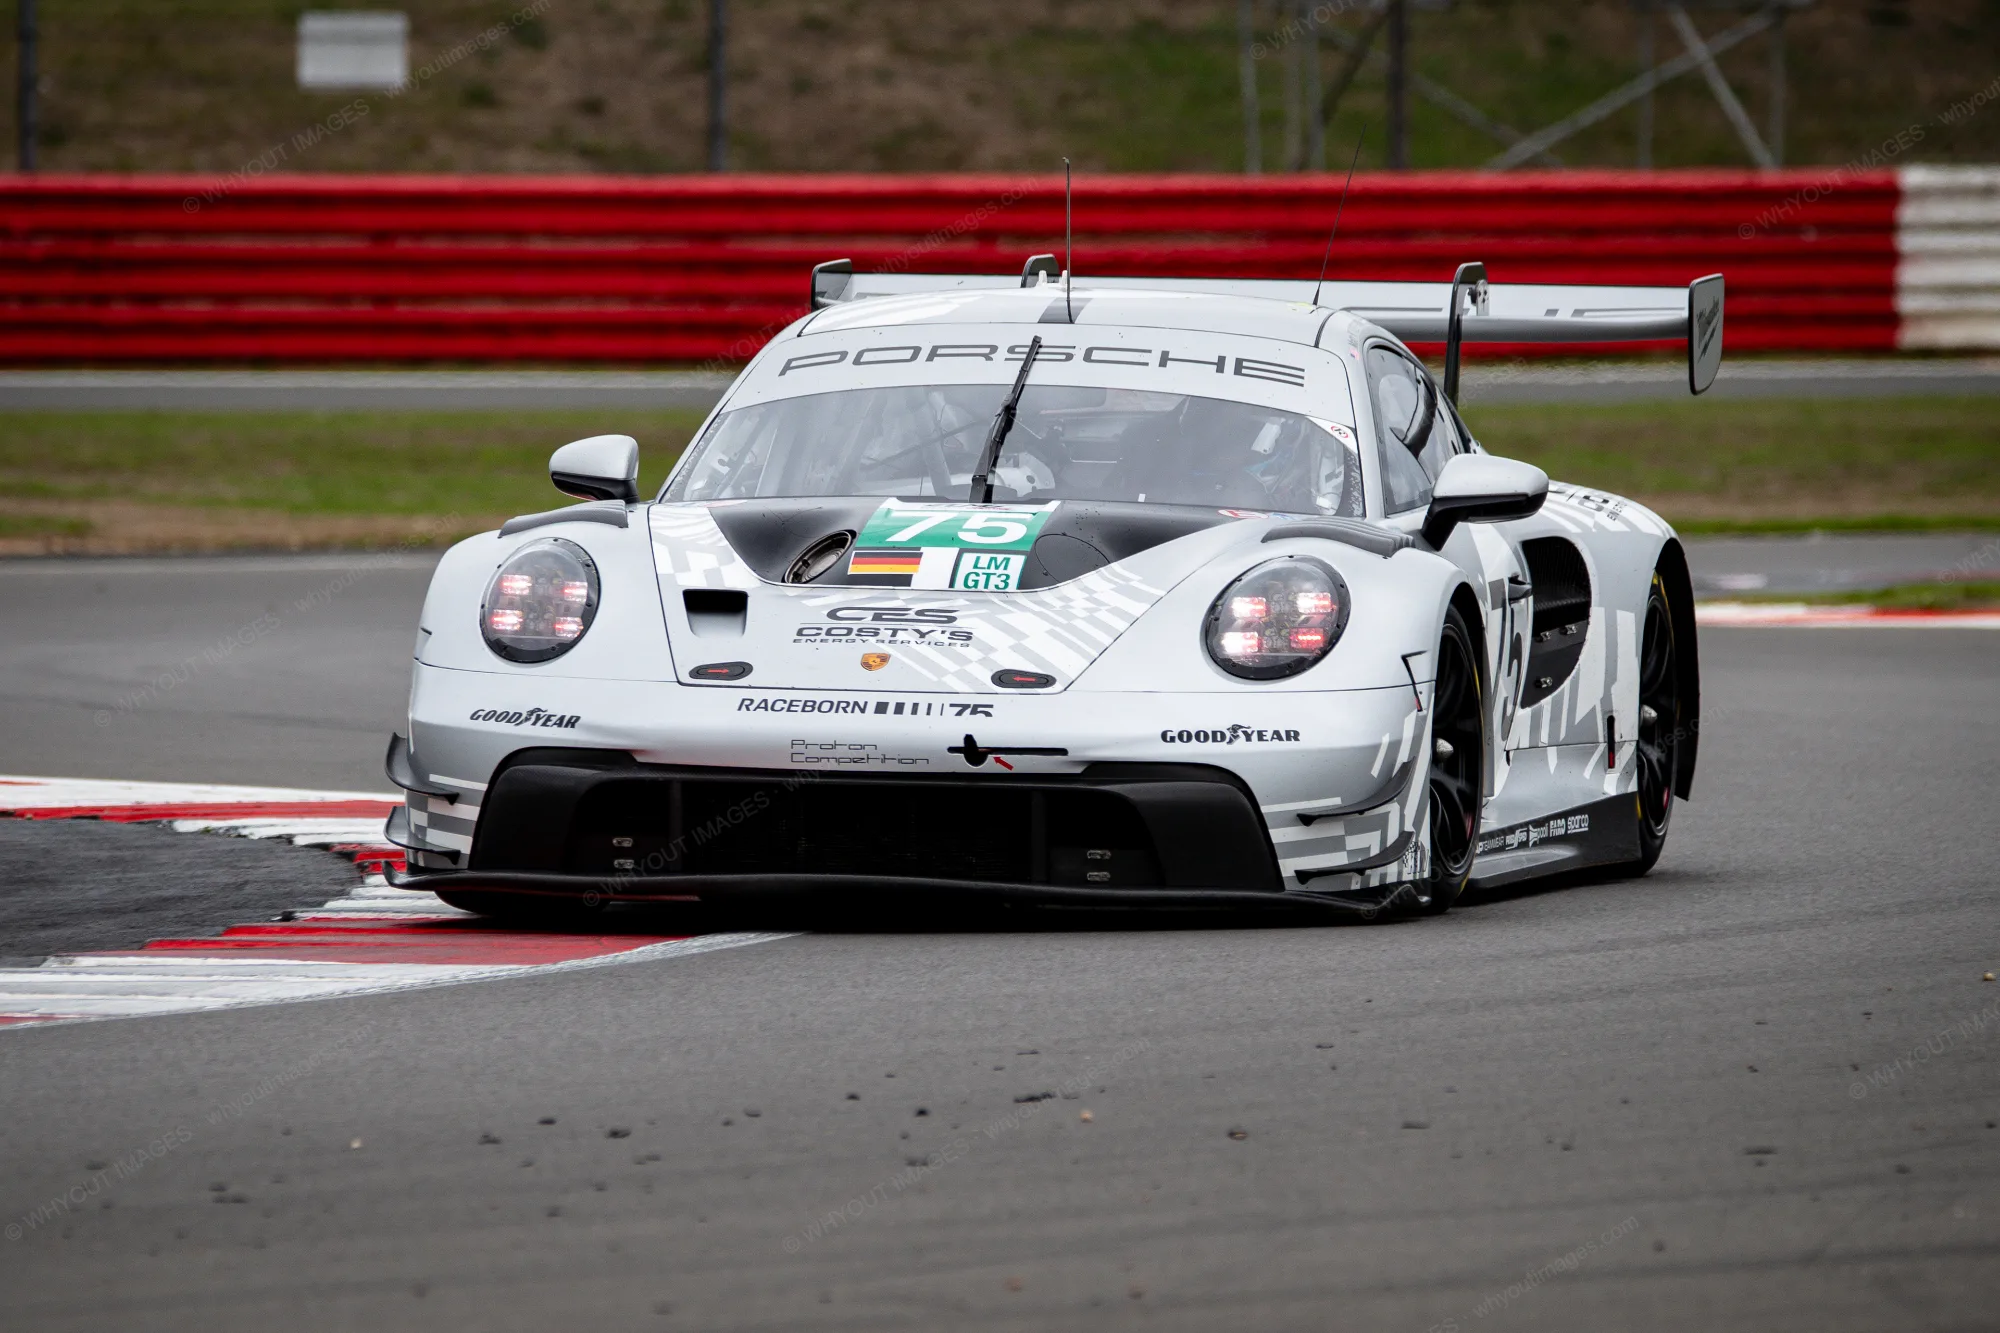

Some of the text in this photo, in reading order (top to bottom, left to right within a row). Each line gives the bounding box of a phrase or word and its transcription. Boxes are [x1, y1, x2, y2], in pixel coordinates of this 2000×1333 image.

[778, 344, 1305, 387] PORSCHE
[885, 511, 1032, 544] 75
[972, 555, 1011, 571] LM
[963, 571, 1010, 590] GT3
[826, 606, 960, 625] CES
[796, 626, 974, 642] COSTY'S
[876, 638, 971, 648] SERVICES
[737, 698, 994, 718] RACEBORN 75
[470, 707, 581, 729] GOODYEAR
[1161, 726, 1300, 744] GOODYEAR
[791, 740, 877, 750] Proton
[791, 752, 929, 766] Competition
